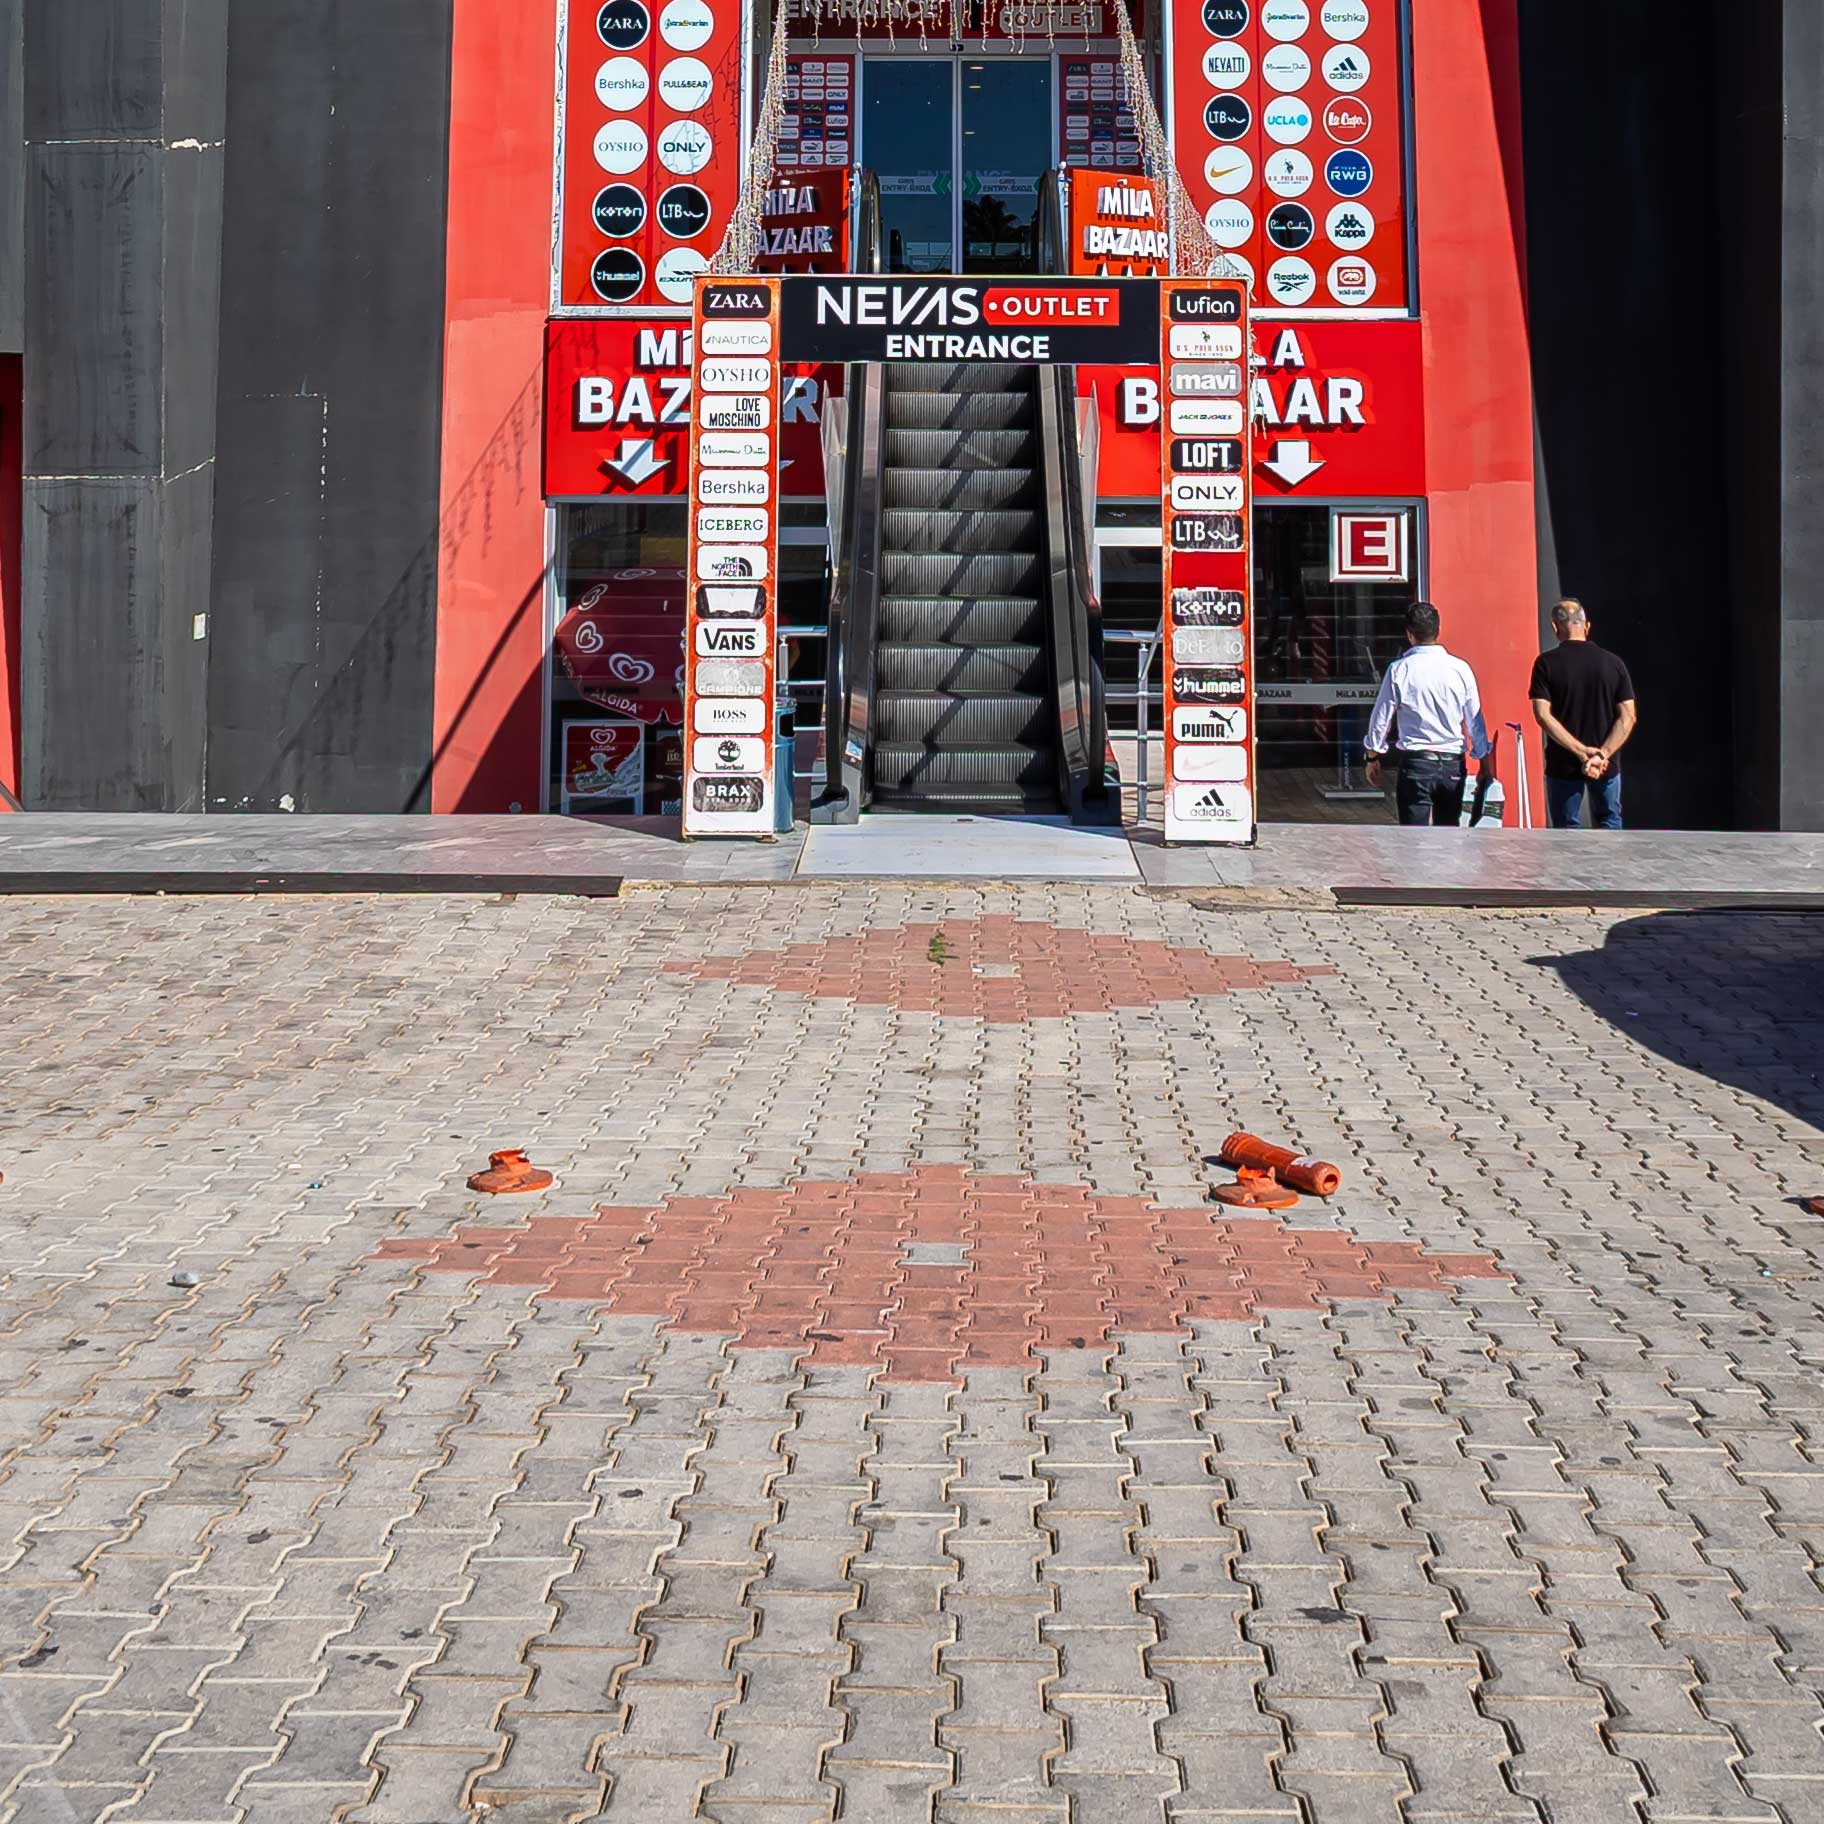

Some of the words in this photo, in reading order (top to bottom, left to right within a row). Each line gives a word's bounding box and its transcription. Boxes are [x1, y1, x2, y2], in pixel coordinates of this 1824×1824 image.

[1207, 10, 1244, 20] ZARA
[1324, 13, 1365, 22] Bershka
[603, 18, 642, 29] ZARA
[1209, 57, 1244, 73] NEVATTI
[1329, 71, 1363, 80] adidas
[599, 78, 645, 89] Bershka
[663, 80, 708, 88] PULL&BEAR
[1209, 111, 1226, 124] LTB
[1268, 116, 1296, 126] UCLA
[599, 142, 643, 153] OYSHO
[663, 142, 706, 153] ONLY
[1331, 171, 1366, 181] RWB
[662, 204, 681, 218] LTB
[1210, 219, 1249, 228] OYSHO
[757, 226, 833, 254] AZAAR
[1335, 228, 1365, 238] Kappa
[1088, 226, 1169, 259] BAZAAR
[602, 271, 640, 281] hummel
[1274, 272, 1309, 281] Reebok
[710, 293, 764, 308] ZARA
[817, 286, 978, 325] NEVAS
[1003, 297, 1110, 317] OUTLET
[1176, 296, 1235, 313] Lufian
[711, 336, 768, 344] NAUTICA
[886, 334, 1050, 359] ENTRANCE
[702, 368, 769, 382] OYSHO
[1176, 370, 1236, 390] mavi
[578, 376, 821, 424] BAZR
[736, 398, 760, 412] LOVE
[1124, 377, 1367, 425] BAAR
[709, 413, 761, 427] MOSCHINO
[1181, 443, 1231, 468] LOFT
[702, 480, 765, 495] Bershka
[1177, 486, 1237, 500] ONLY
[699, 519, 763, 531] ICEBERG
[1175, 521, 1206, 542] LTB
[1350, 521, 1389, 566] E
[703, 628, 756, 650] VANS
[1184, 677, 1245, 694] hummel
[713, 709, 747, 719] BOSS
[1181, 723, 1225, 737] PUMA
[706, 785, 751, 796] BRAX
[1190, 807, 1232, 817] adidas
